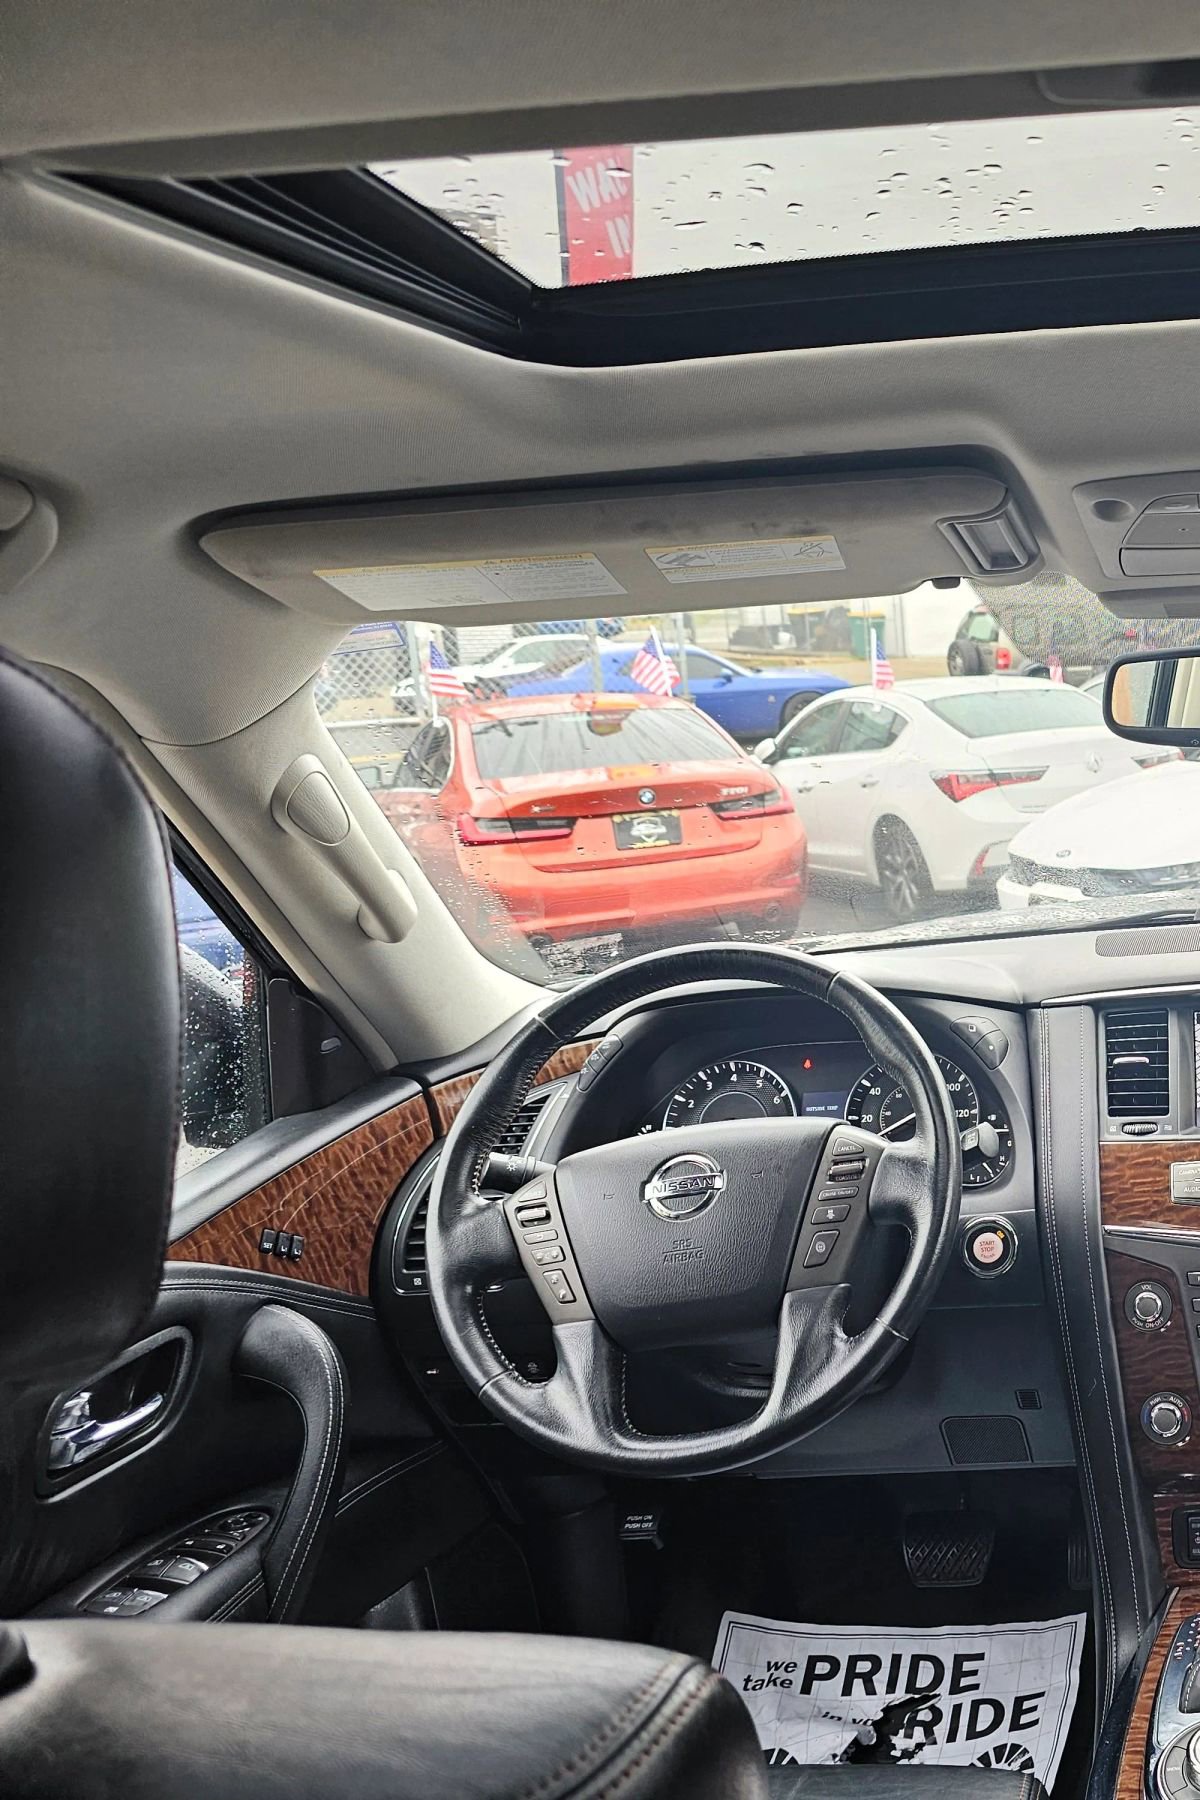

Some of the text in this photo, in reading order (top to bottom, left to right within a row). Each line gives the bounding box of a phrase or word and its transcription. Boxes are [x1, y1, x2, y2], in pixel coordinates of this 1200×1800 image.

[730, 1073, 738, 1082] 4
[705, 1081, 713, 1091] 3
[755, 1079, 763, 1088] 5
[869, 1087, 881, 1096] 40
[687, 1099, 695, 1108] 2
[773, 1096, 781, 1104] 6
[861, 1114, 873, 1123] 20
[955, 1109, 970, 1118] 120
[652, 1176, 715, 1194] NISSAN
[672, 1238, 693, 1250] SRS
[662, 1250, 704, 1265] AIRBAG
[1168, 1395, 1183, 1408] AUTO
[766, 1659, 798, 1675] we
[800, 1652, 986, 1697] PRIDE
[743, 1672, 794, 1692] take
[903, 1690, 1047, 1746] RIDE
